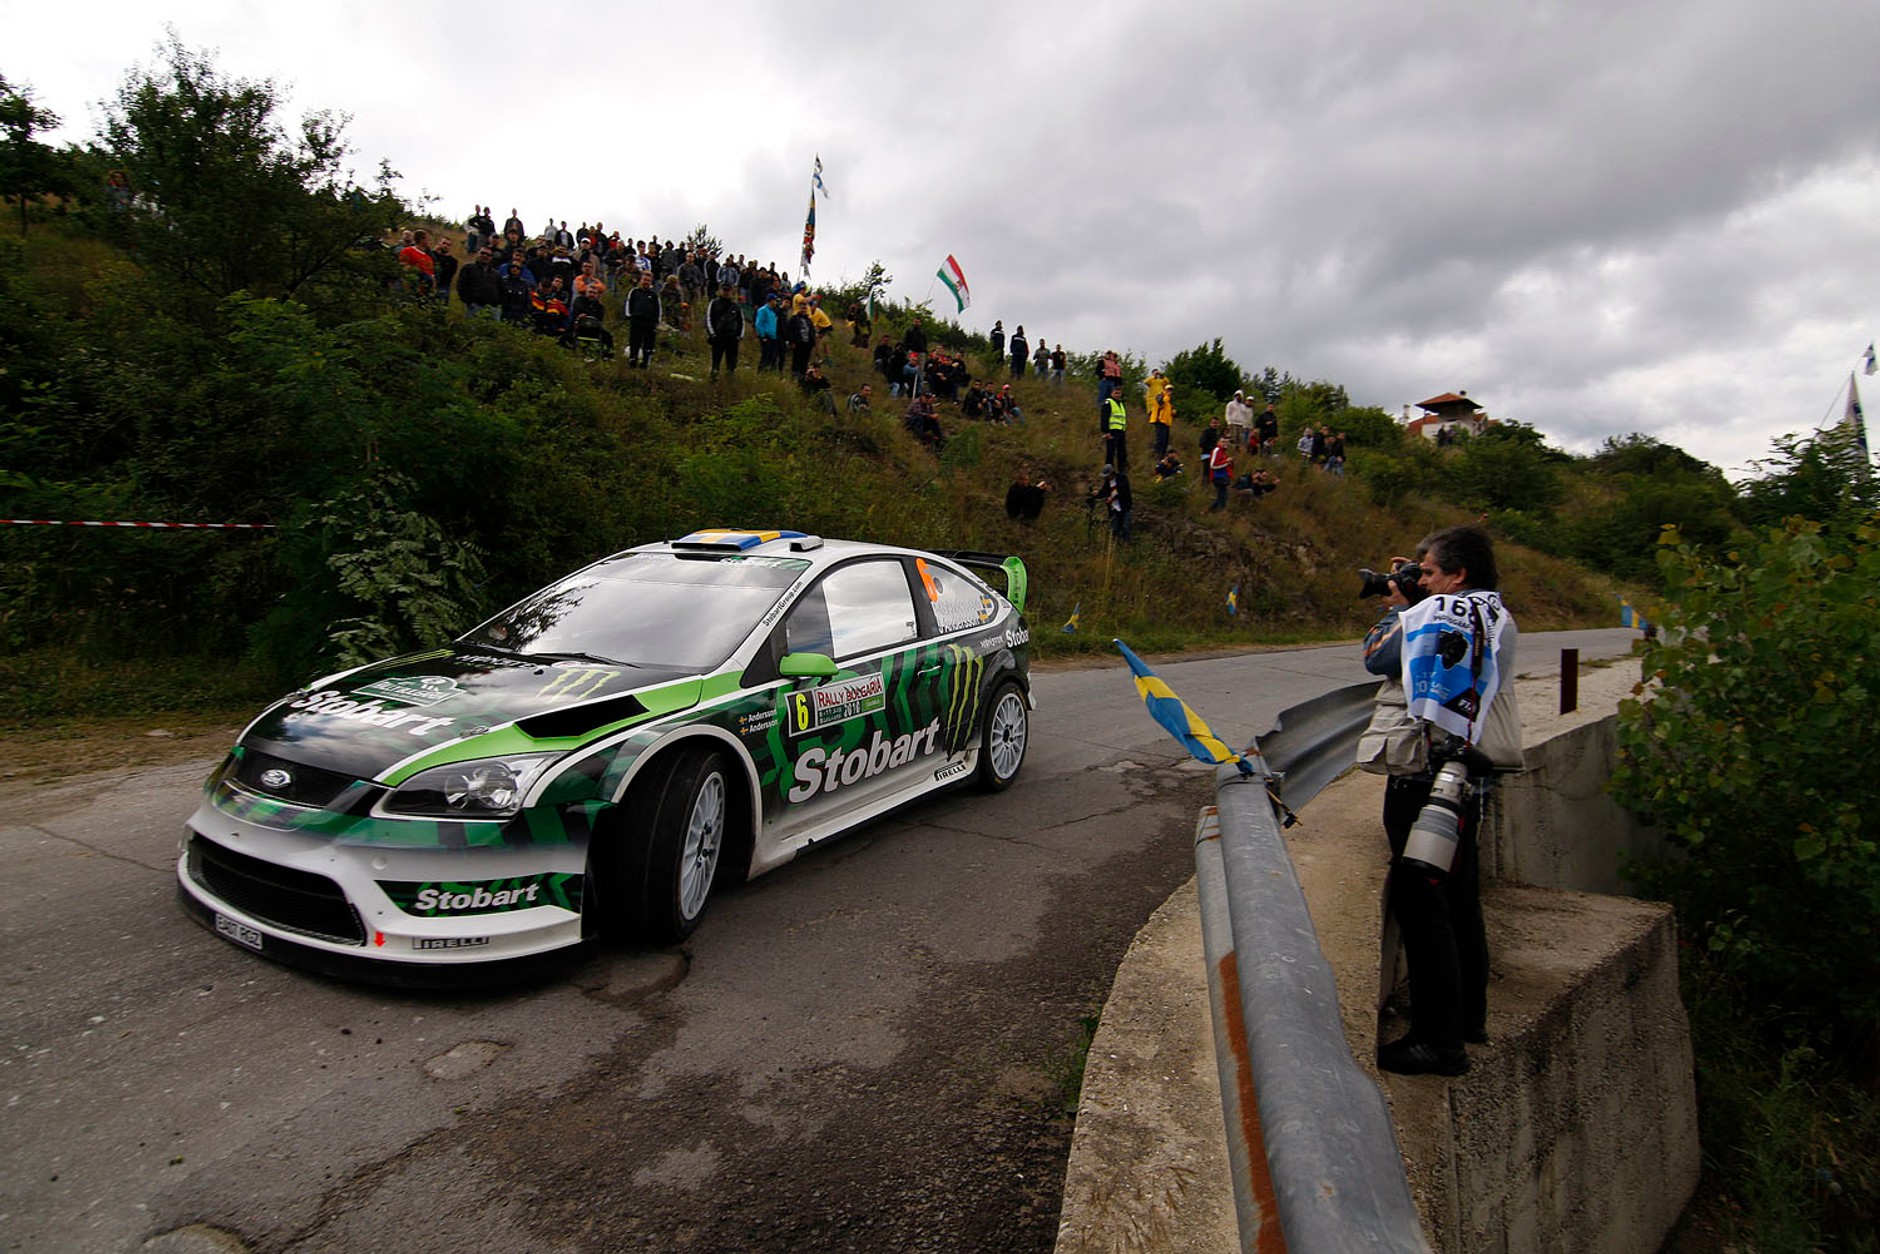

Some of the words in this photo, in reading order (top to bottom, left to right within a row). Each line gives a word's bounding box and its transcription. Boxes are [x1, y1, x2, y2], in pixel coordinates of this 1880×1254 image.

[916, 558, 938, 603] 6
[763, 581, 804, 627] StobartGroup.com
[817, 690, 845, 709] RALLY
[846, 679, 883, 701] BULGARIA
[291, 690, 457, 736] Stobart
[749, 709, 777, 722] Andersson
[795, 693, 809, 731] 6
[843, 701, 861, 718] 2010
[750, 719, 779, 733] Andersson
[788, 716, 941, 803] Stobart
[934, 760, 967, 781] PIRELLI
[414, 883, 540, 910] Stobart
[412, 937, 490, 949] PIRELLI
